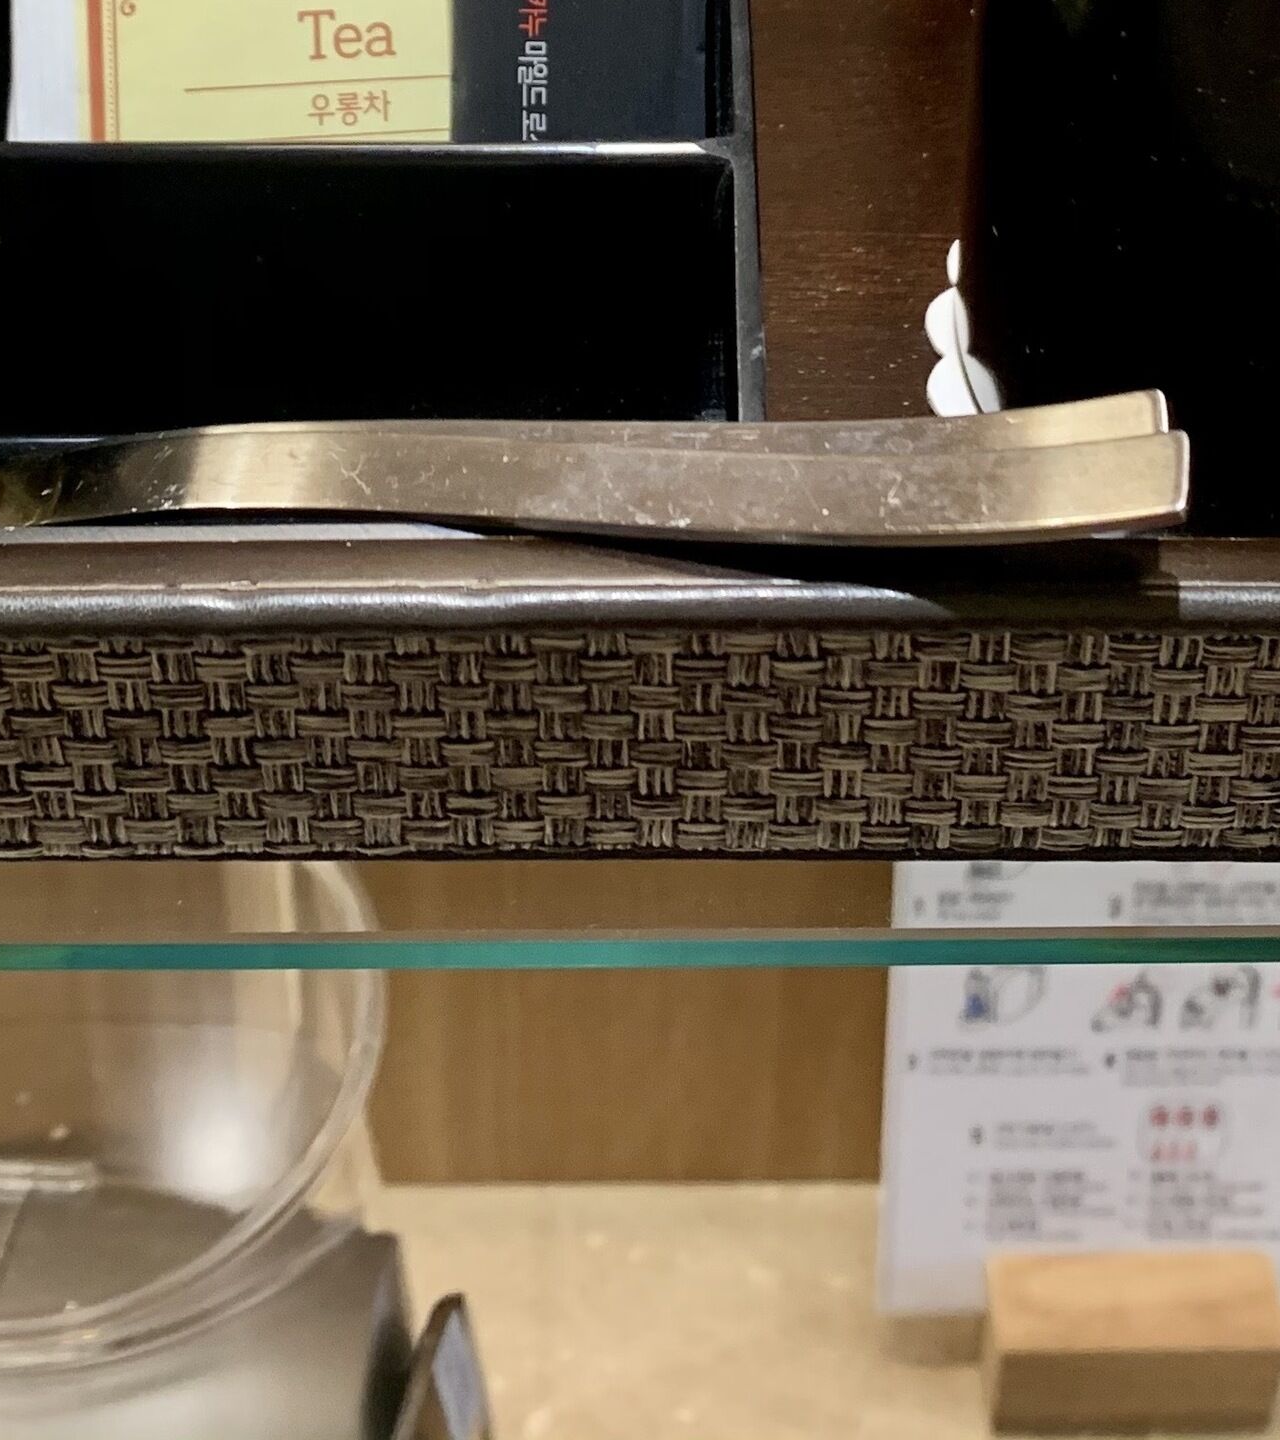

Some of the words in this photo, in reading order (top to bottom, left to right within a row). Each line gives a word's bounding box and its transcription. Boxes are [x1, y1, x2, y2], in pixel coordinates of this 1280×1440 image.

[297, 9, 396, 60] Tea
[307, 89, 391, 126] 우롱차
[518, 109, 547, 142] 로
